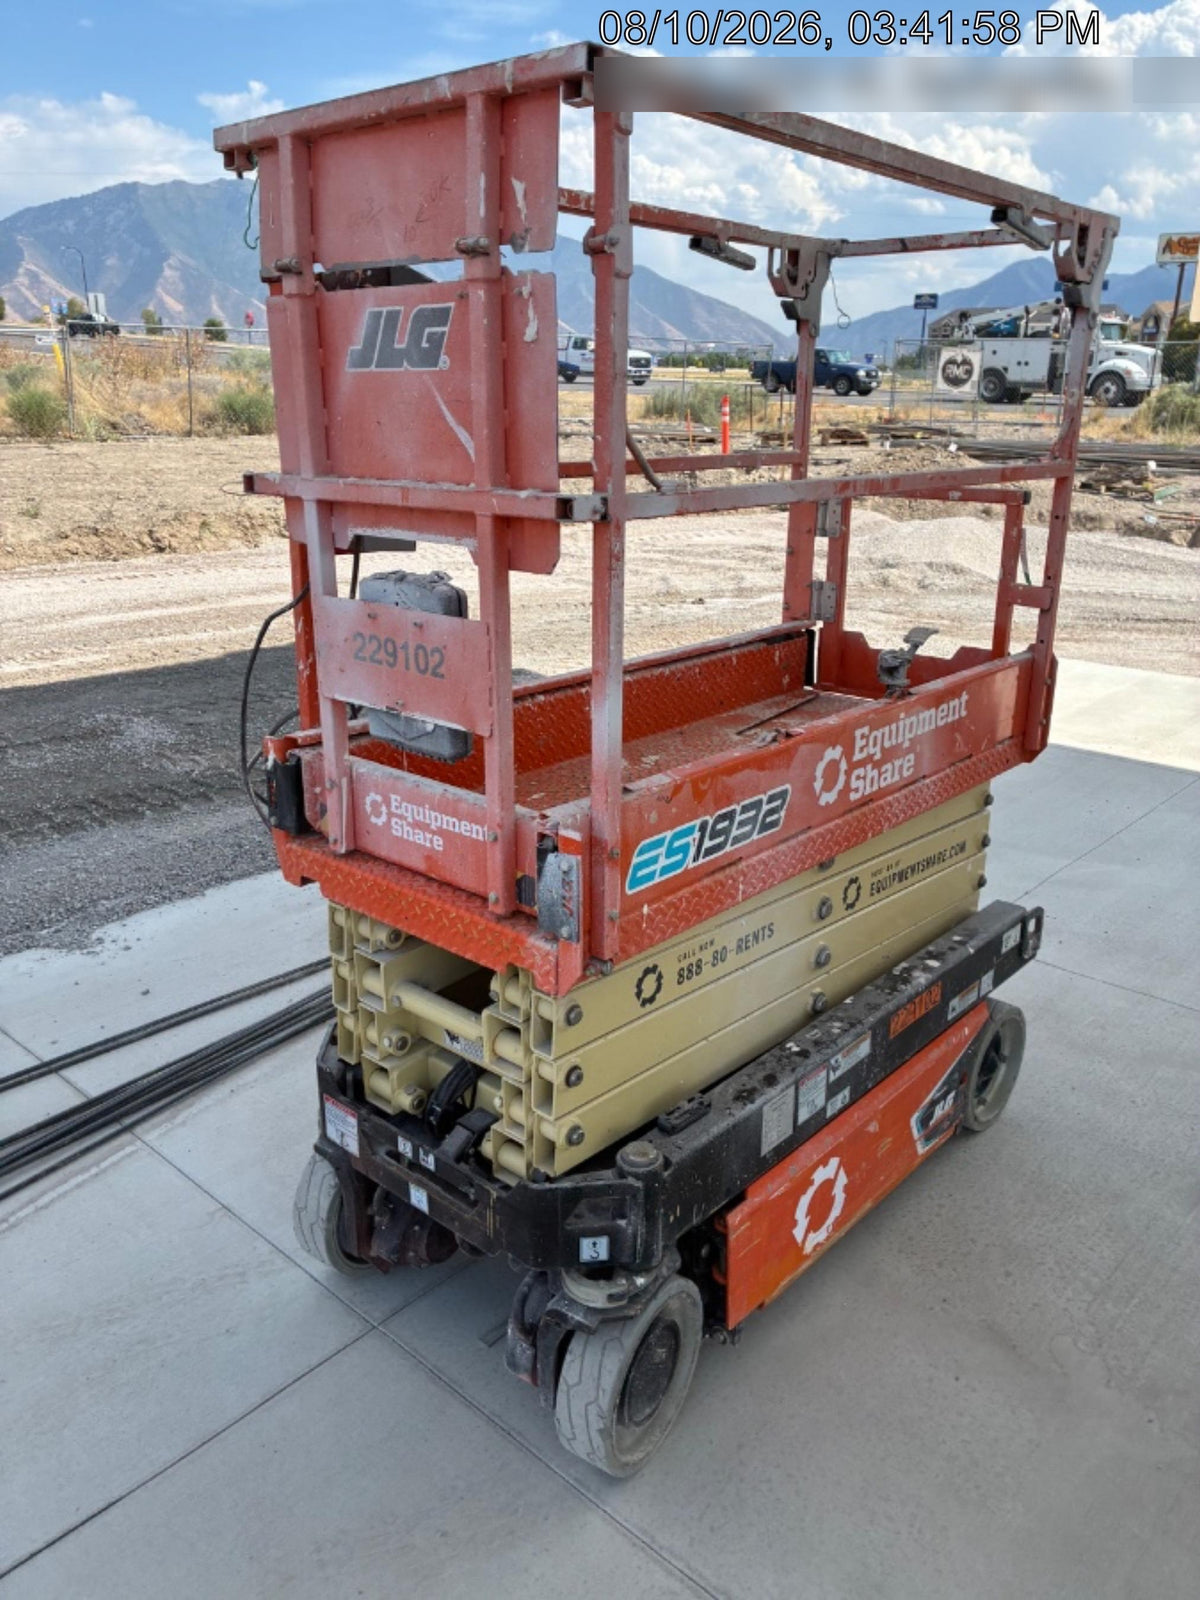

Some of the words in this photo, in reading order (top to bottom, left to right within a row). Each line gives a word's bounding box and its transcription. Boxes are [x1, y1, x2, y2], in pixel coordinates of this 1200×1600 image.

[346, 302, 455, 371] JLG
[352, 631, 445, 680] 229102
[853, 690, 969, 762] Equipment
[849, 753, 915, 801] Share
[391, 817, 443, 851] Share
[626, 784, 792, 894] ES1932
[870, 840, 967, 897] EQUIPMENTSHARE.COM
[676, 922, 775, 986] 888-80-RENTS
[677, 949, 696, 963] CALL
